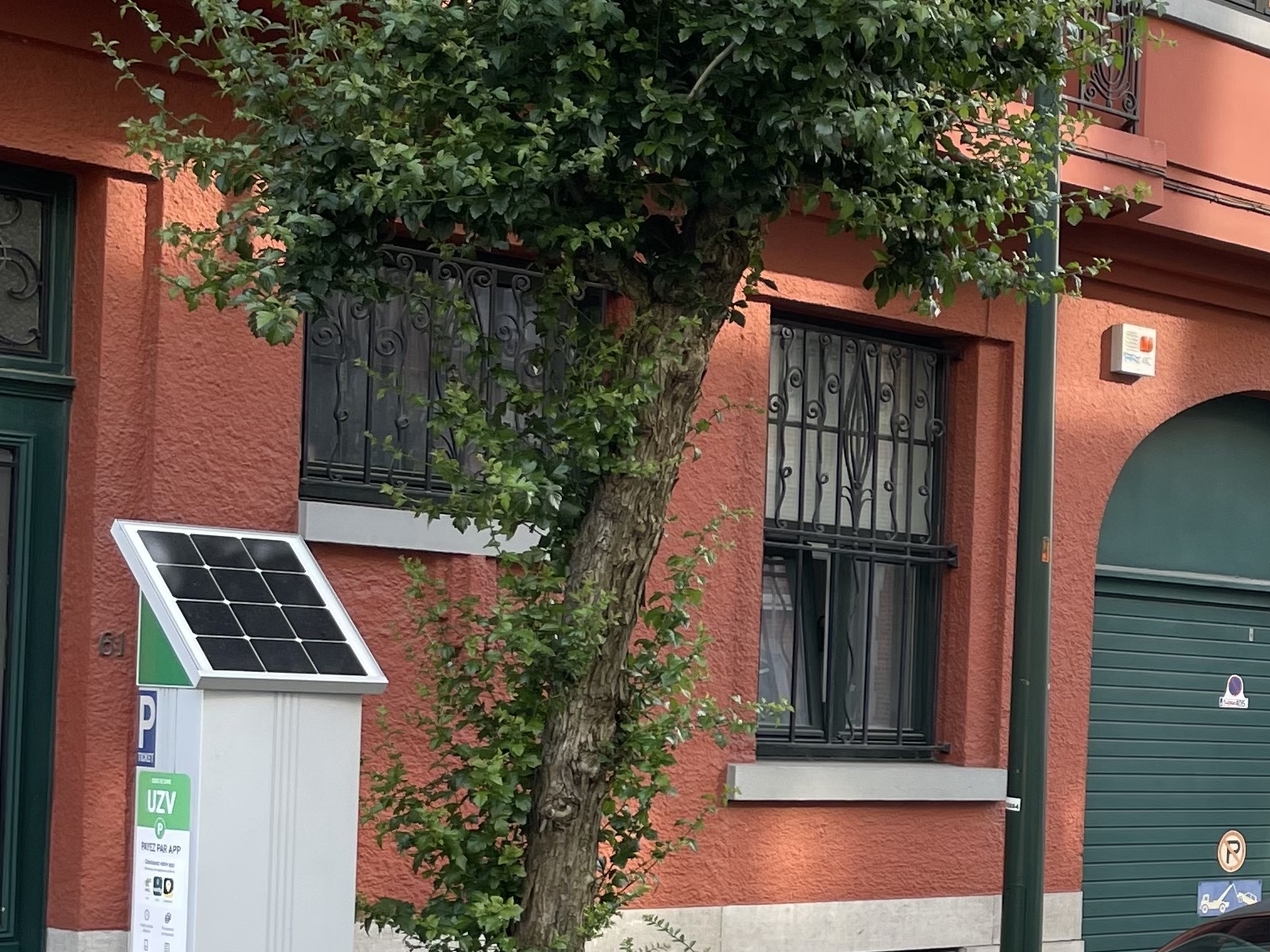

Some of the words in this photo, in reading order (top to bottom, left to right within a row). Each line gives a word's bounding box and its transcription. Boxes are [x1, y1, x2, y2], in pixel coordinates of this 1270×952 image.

[101, 632, 125, 656] 61
[138, 695, 156, 749] P
[147, 789, 177, 815] UZV
[157, 822, 164, 836] P
[141, 841, 156, 852] PAYEZ
[156, 843, 168, 854] PAR
[168, 845, 181, 855] APP
[1226, 840, 1241, 865] P
